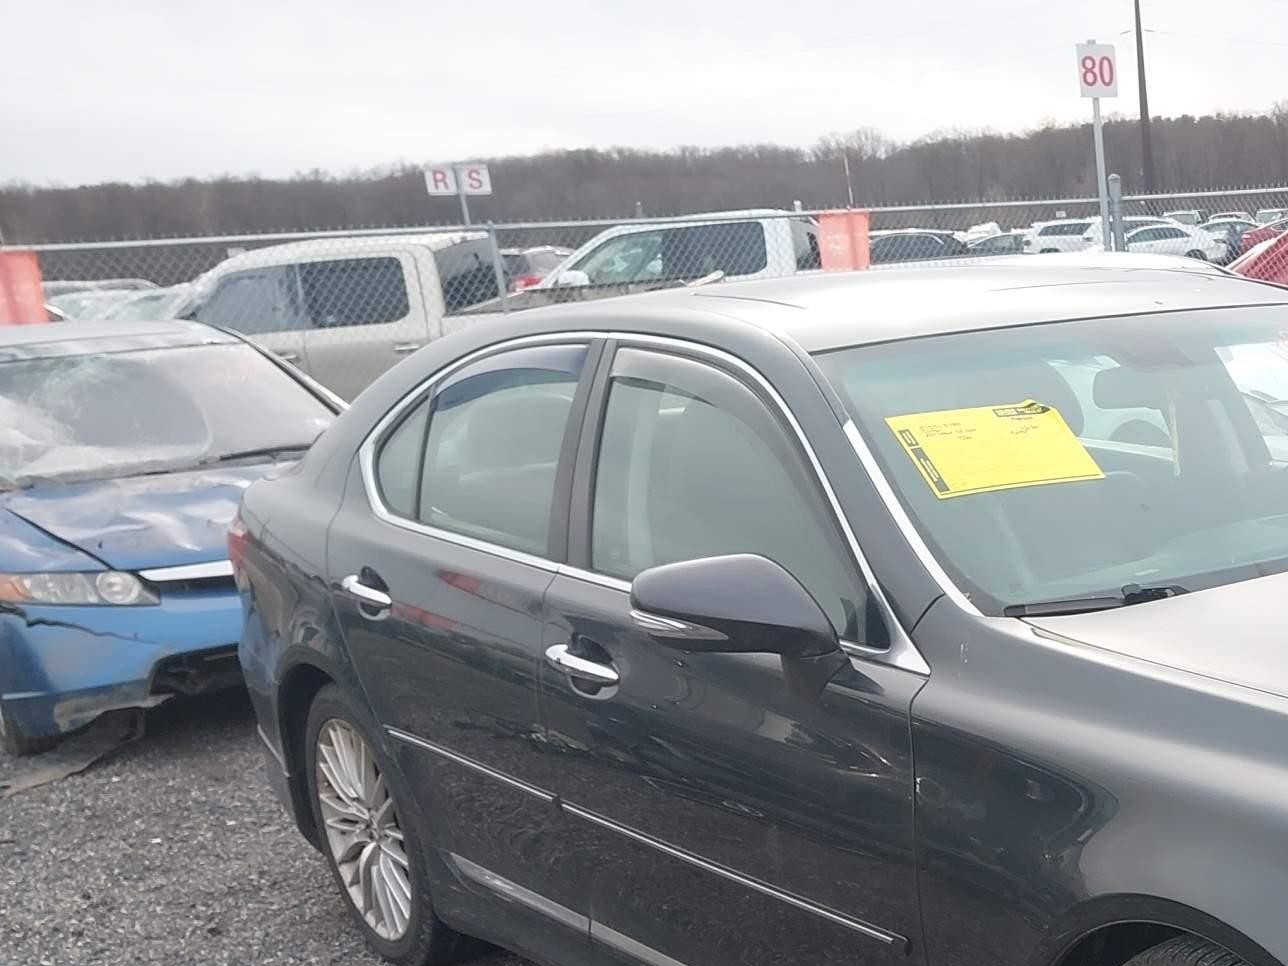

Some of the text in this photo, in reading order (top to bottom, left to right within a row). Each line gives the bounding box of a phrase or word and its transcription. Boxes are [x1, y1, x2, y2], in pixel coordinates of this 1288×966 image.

[1081, 55, 1114, 87] 80
[432, 169, 449, 191] R
[467, 168, 483, 190] S
